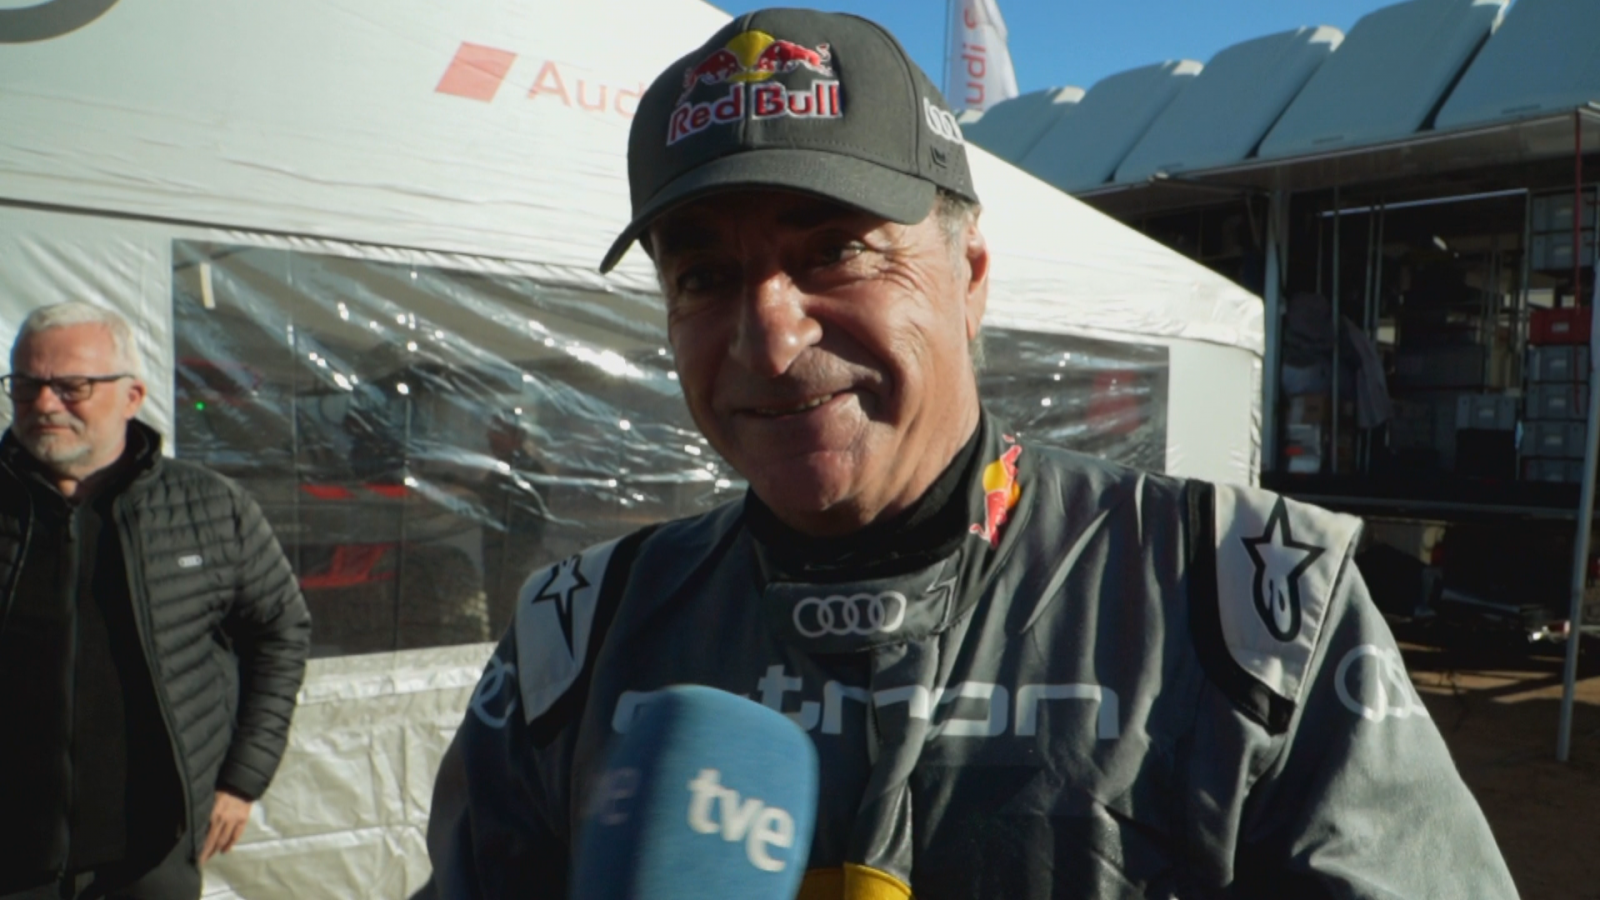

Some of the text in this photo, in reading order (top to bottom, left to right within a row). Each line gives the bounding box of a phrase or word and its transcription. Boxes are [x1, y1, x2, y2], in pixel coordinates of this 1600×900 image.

[961, 43, 986, 112] udi
[667, 80, 842, 146] Red Bull
[687, 767, 795, 872] tve
